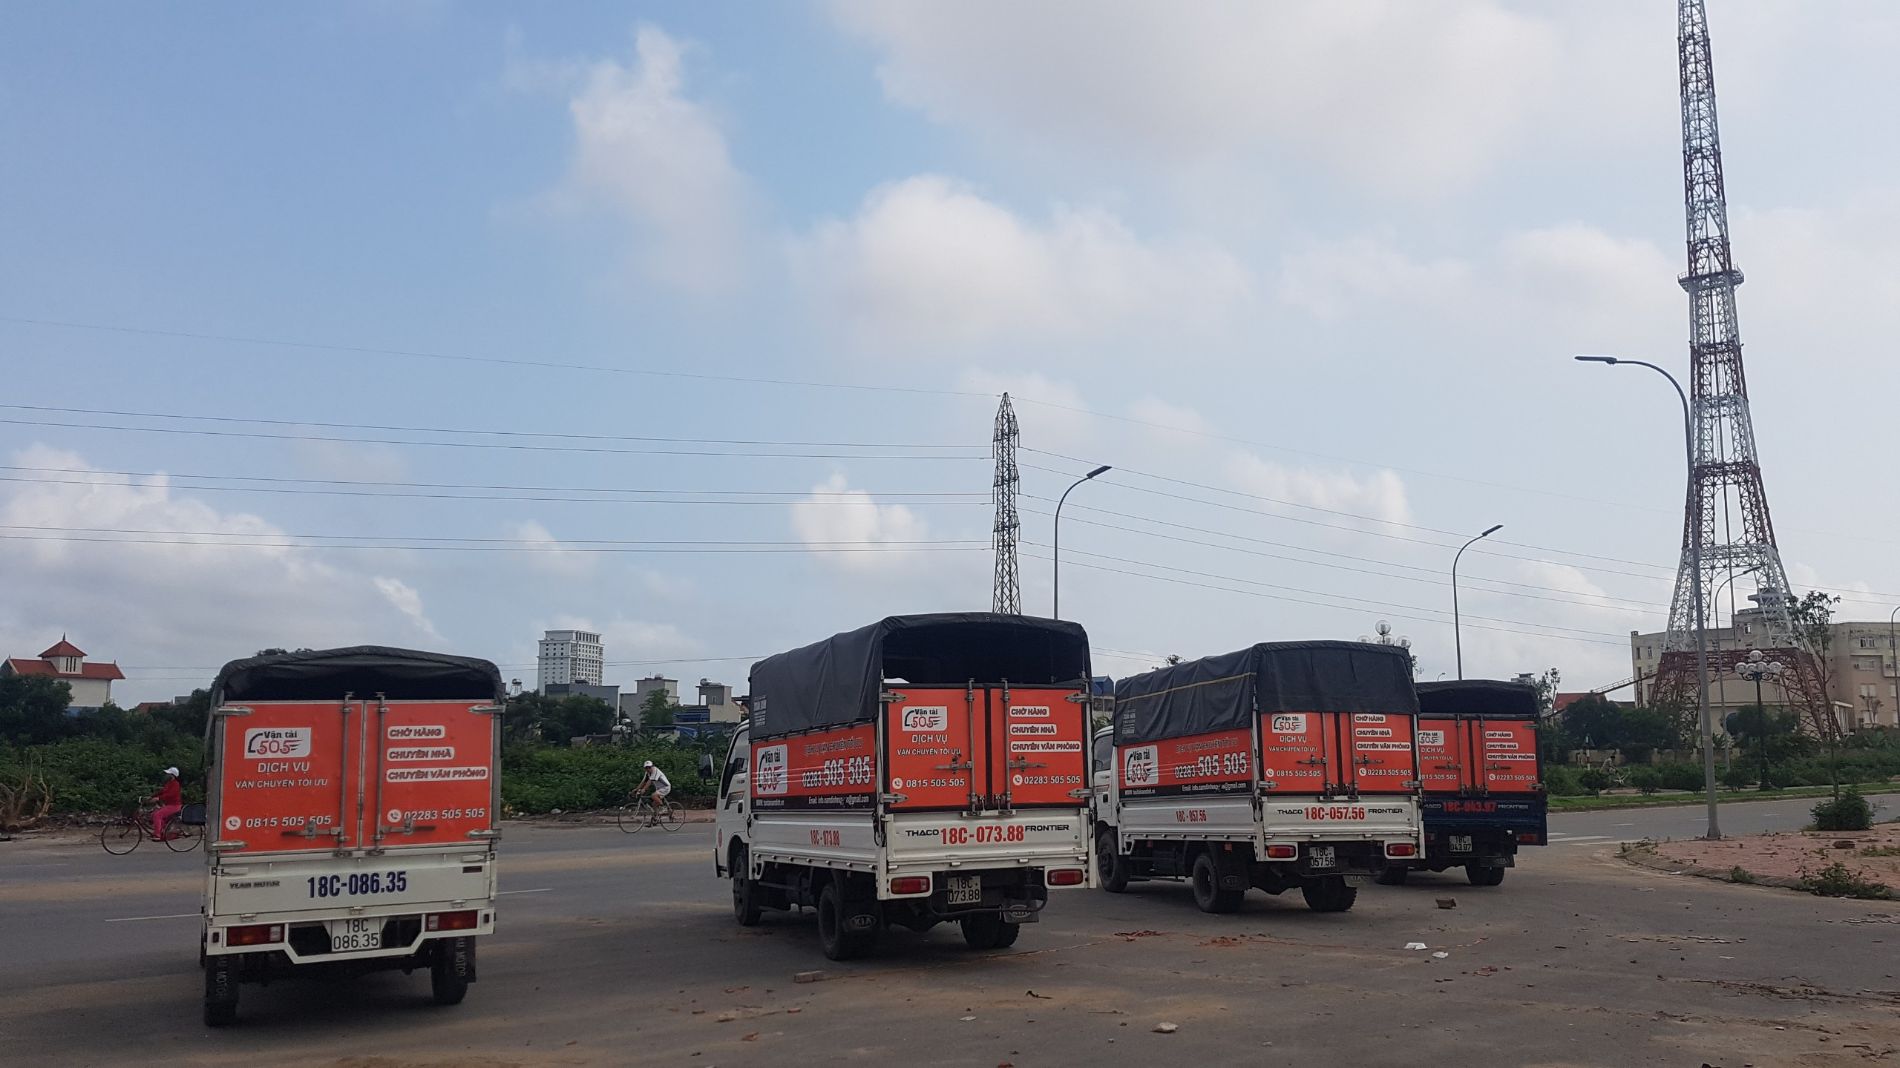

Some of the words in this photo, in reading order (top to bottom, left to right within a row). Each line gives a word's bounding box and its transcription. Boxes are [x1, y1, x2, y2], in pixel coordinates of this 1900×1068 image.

[911, 716, 935, 728] 505
[413, 727, 442, 737] HÀNG
[912, 734, 933, 744] DỊCH
[935, 734, 948, 744] VỤ
[257, 740, 294, 755] 505
[257, 762, 289, 774] DỊCH
[292, 761, 310, 774] VỤ
[1197, 754, 1219, 777] 505
[1223, 751, 1247, 775] 505
[824, 759, 844, 786] 505
[848, 756, 870, 784] 505
[906, 779, 928, 788] 0815
[930, 778, 946, 787] 505
[949, 778, 965, 787] 505
[1024, 776, 1048, 784] 02283
[1050, 775, 1064, 784] 505
[1066, 775, 1080, 784] 505
[404, 811, 438, 821] 02283
[441, 809, 462, 819] 505
[465, 808, 485, 818] 505
[246, 817, 277, 828] 0815
[281, 816, 304, 826] 505
[1025, 824, 1069, 832] FRONTIER
[905, 829, 939, 837] THACO
[307, 870, 407, 899] 18C-086.35
[956, 878, 972, 889] 18C
[948, 889, 980, 903] 073.88
[345, 918, 369, 934] 18C
[333, 932, 379, 950] 086.35
